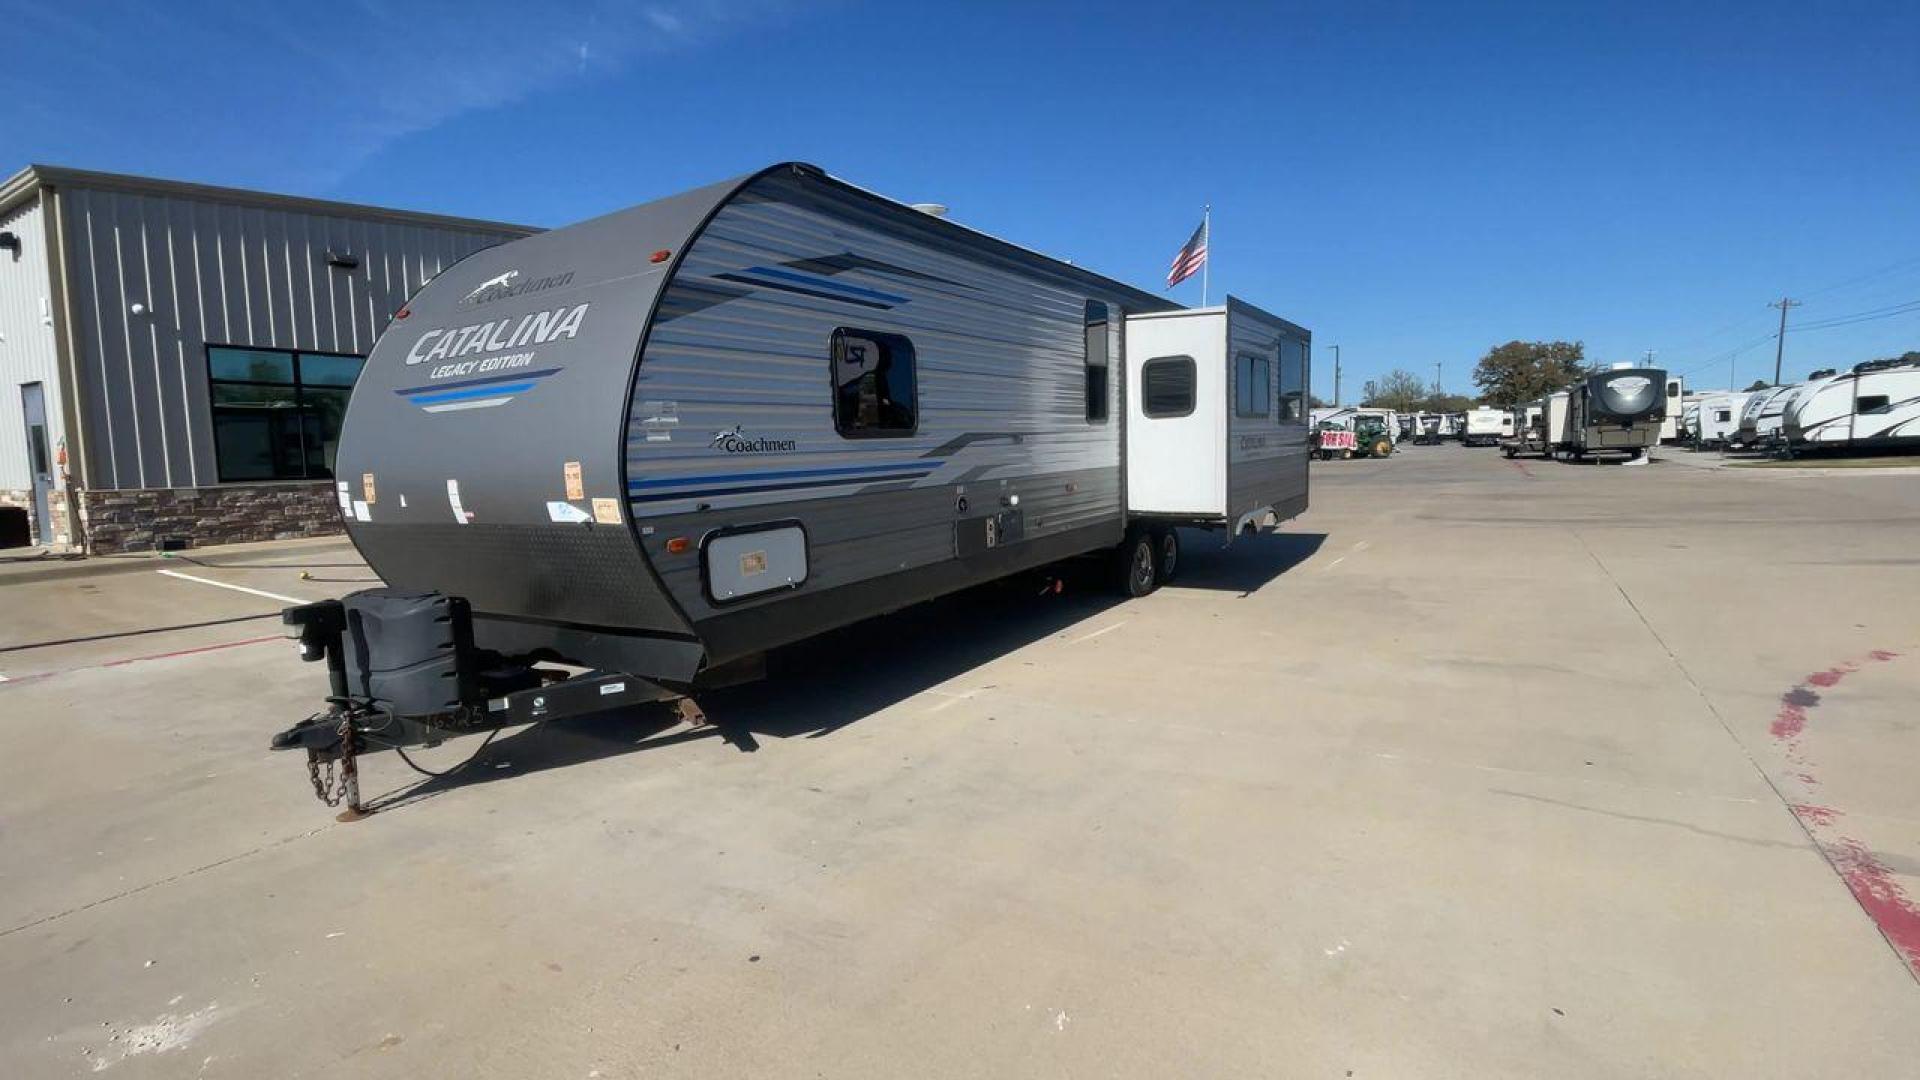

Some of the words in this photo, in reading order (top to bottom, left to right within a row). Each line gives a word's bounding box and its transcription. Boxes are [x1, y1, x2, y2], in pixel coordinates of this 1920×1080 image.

[406, 304, 588, 365] CATALINA
[430, 361, 478, 379] LEGACY
[479, 352, 535, 374] EDITION
[725, 437, 796, 453] Coachmen
